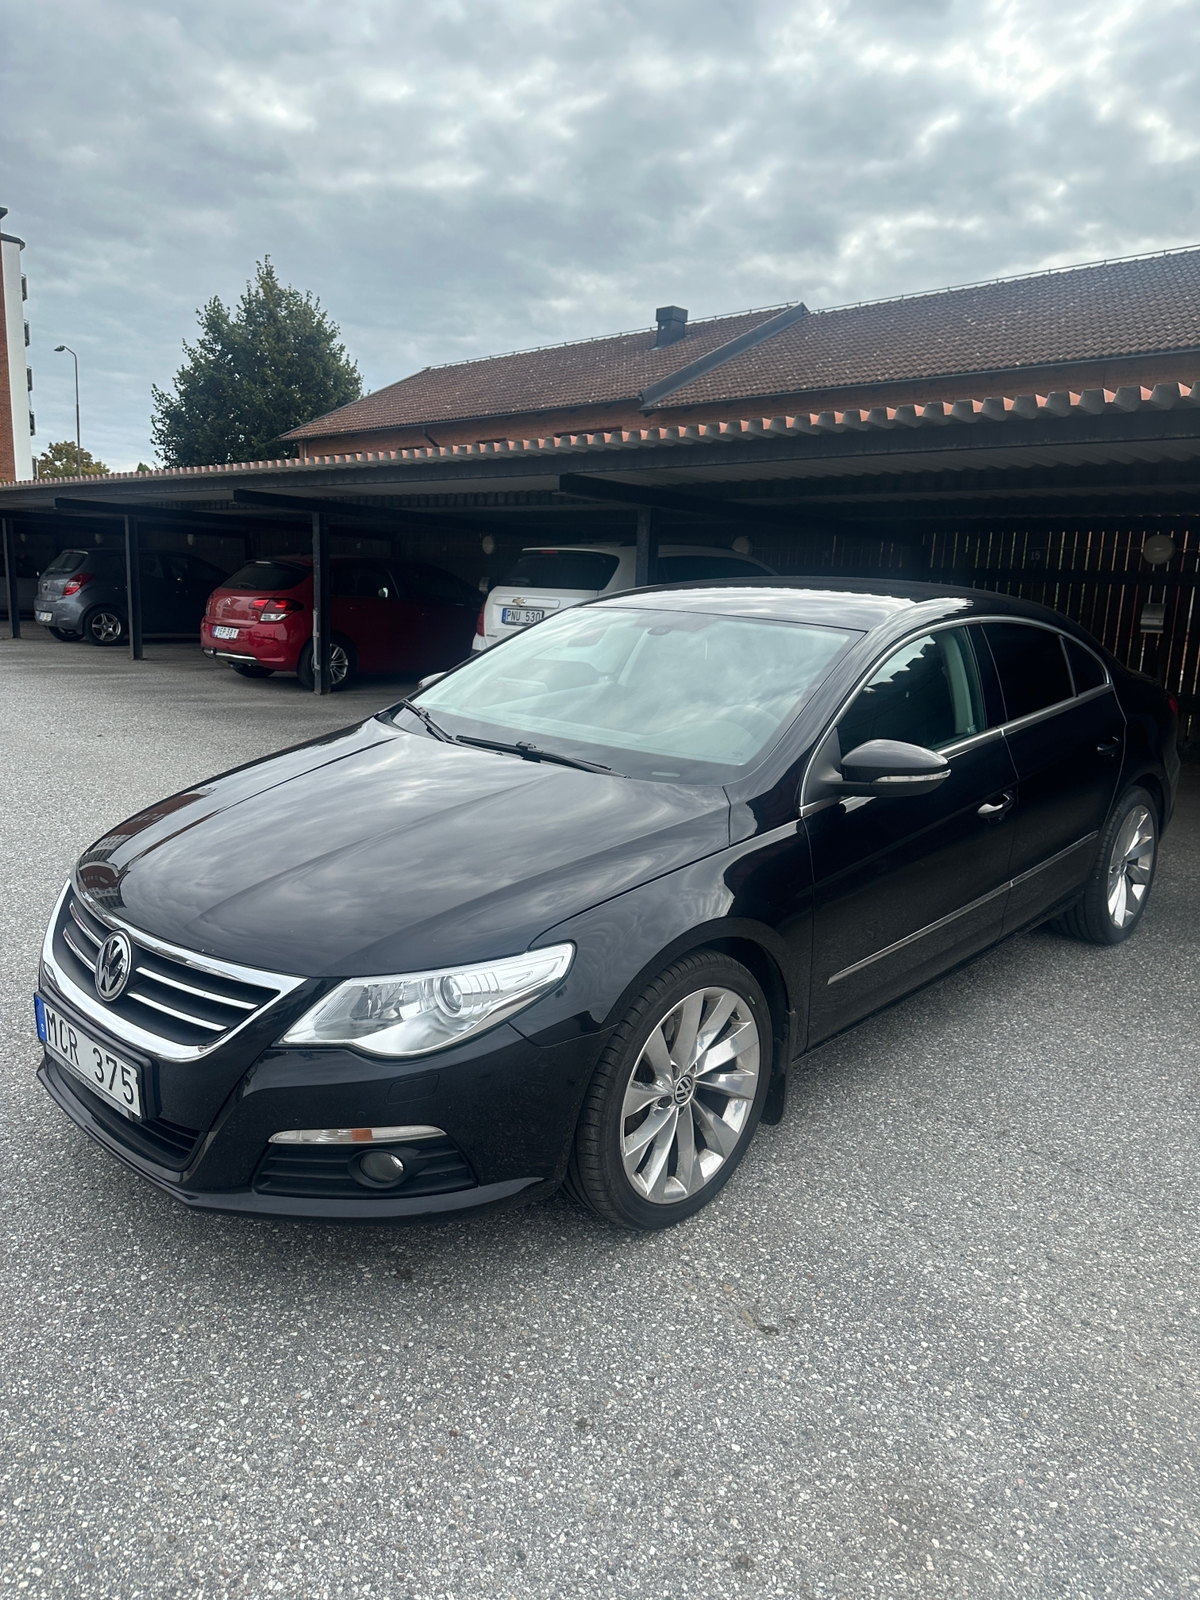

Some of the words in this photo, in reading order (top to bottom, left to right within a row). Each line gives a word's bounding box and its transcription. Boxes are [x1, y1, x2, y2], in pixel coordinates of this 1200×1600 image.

[1030, 550, 1041, 561] 15
[507, 610, 521, 622] PNU
[525, 611, 541, 622] 530
[46, 1008, 80, 1066] MCR
[92, 1047, 134, 1105] 375
